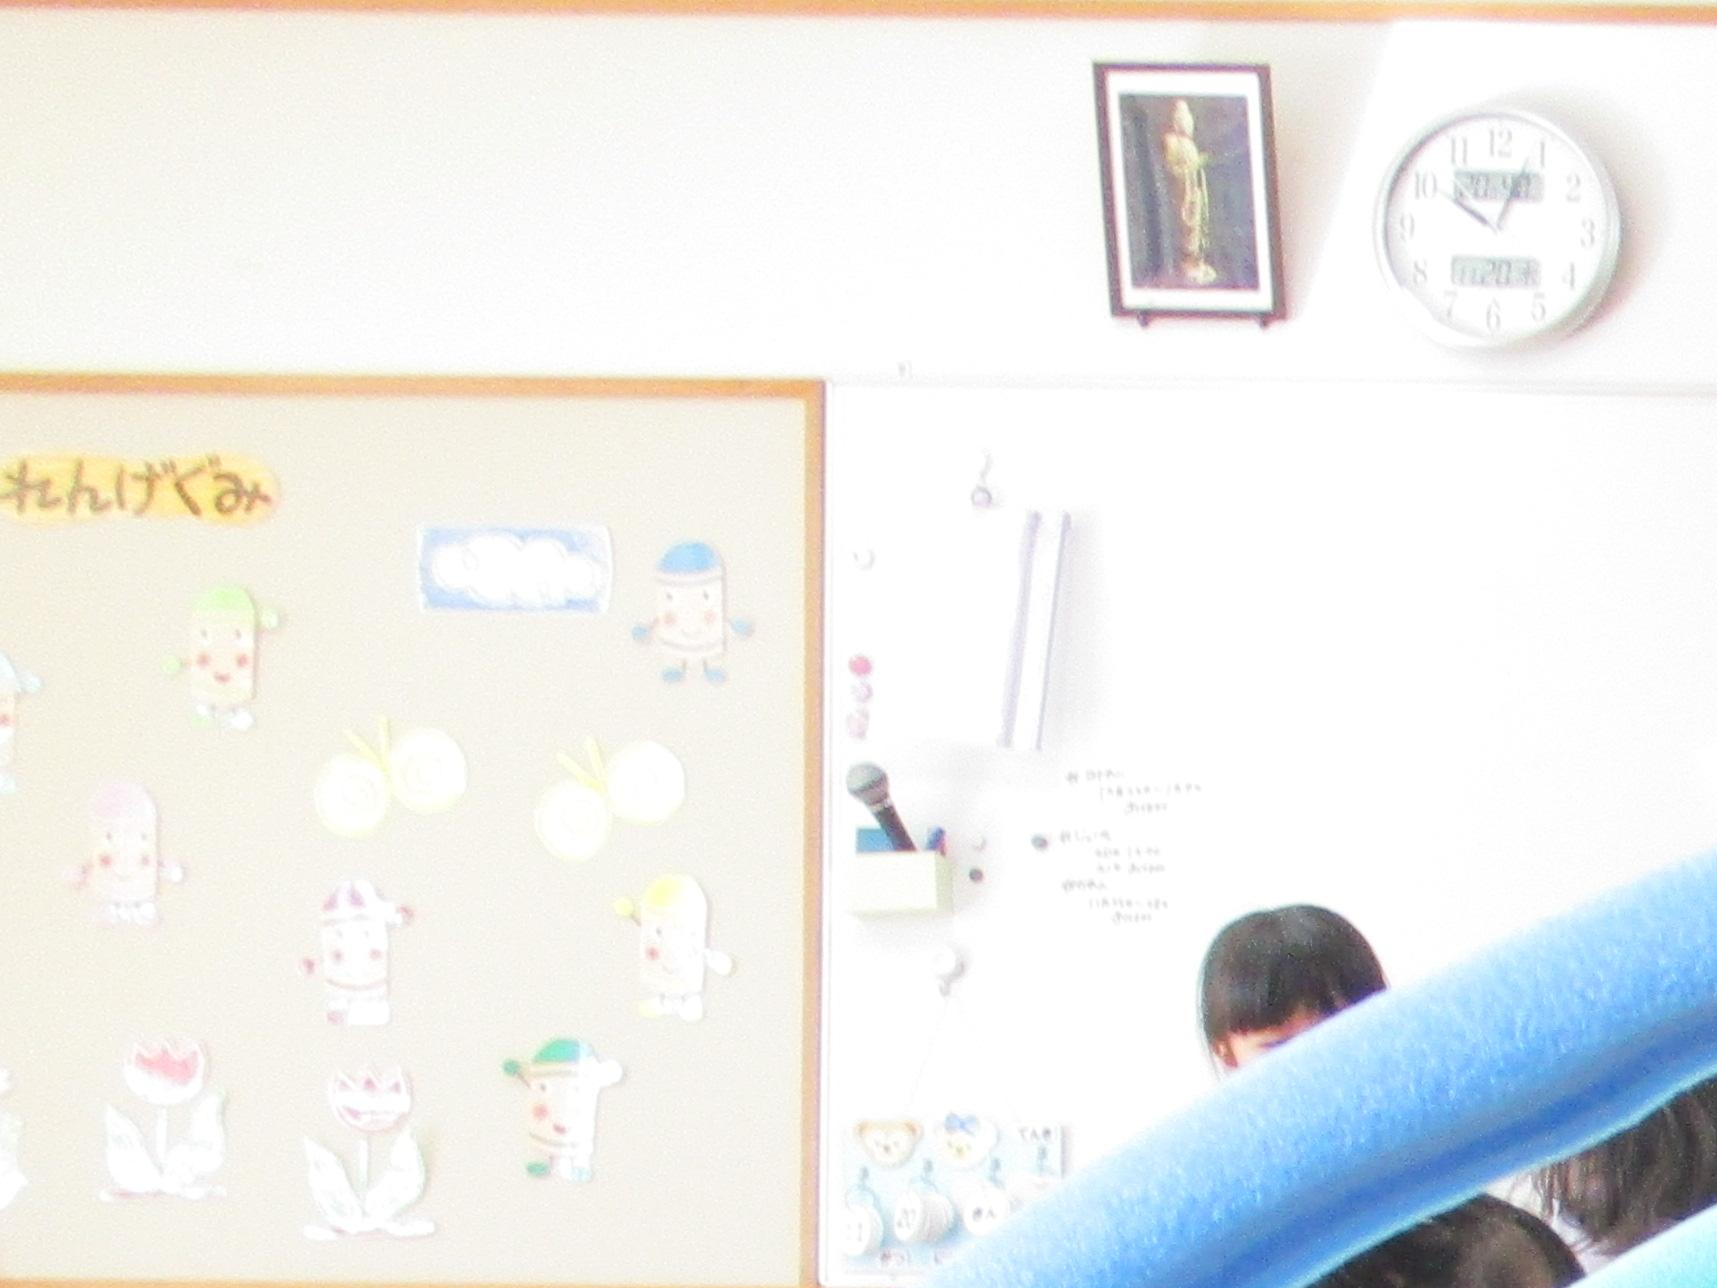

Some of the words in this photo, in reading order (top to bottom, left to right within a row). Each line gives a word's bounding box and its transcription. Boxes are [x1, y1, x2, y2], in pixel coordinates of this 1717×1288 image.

[1450, 137, 1469, 165] 11
[1488, 129, 1513, 157] 12
[1414, 172, 1437, 199] 10
[0, 452, 273, 516] れんげぐみ
